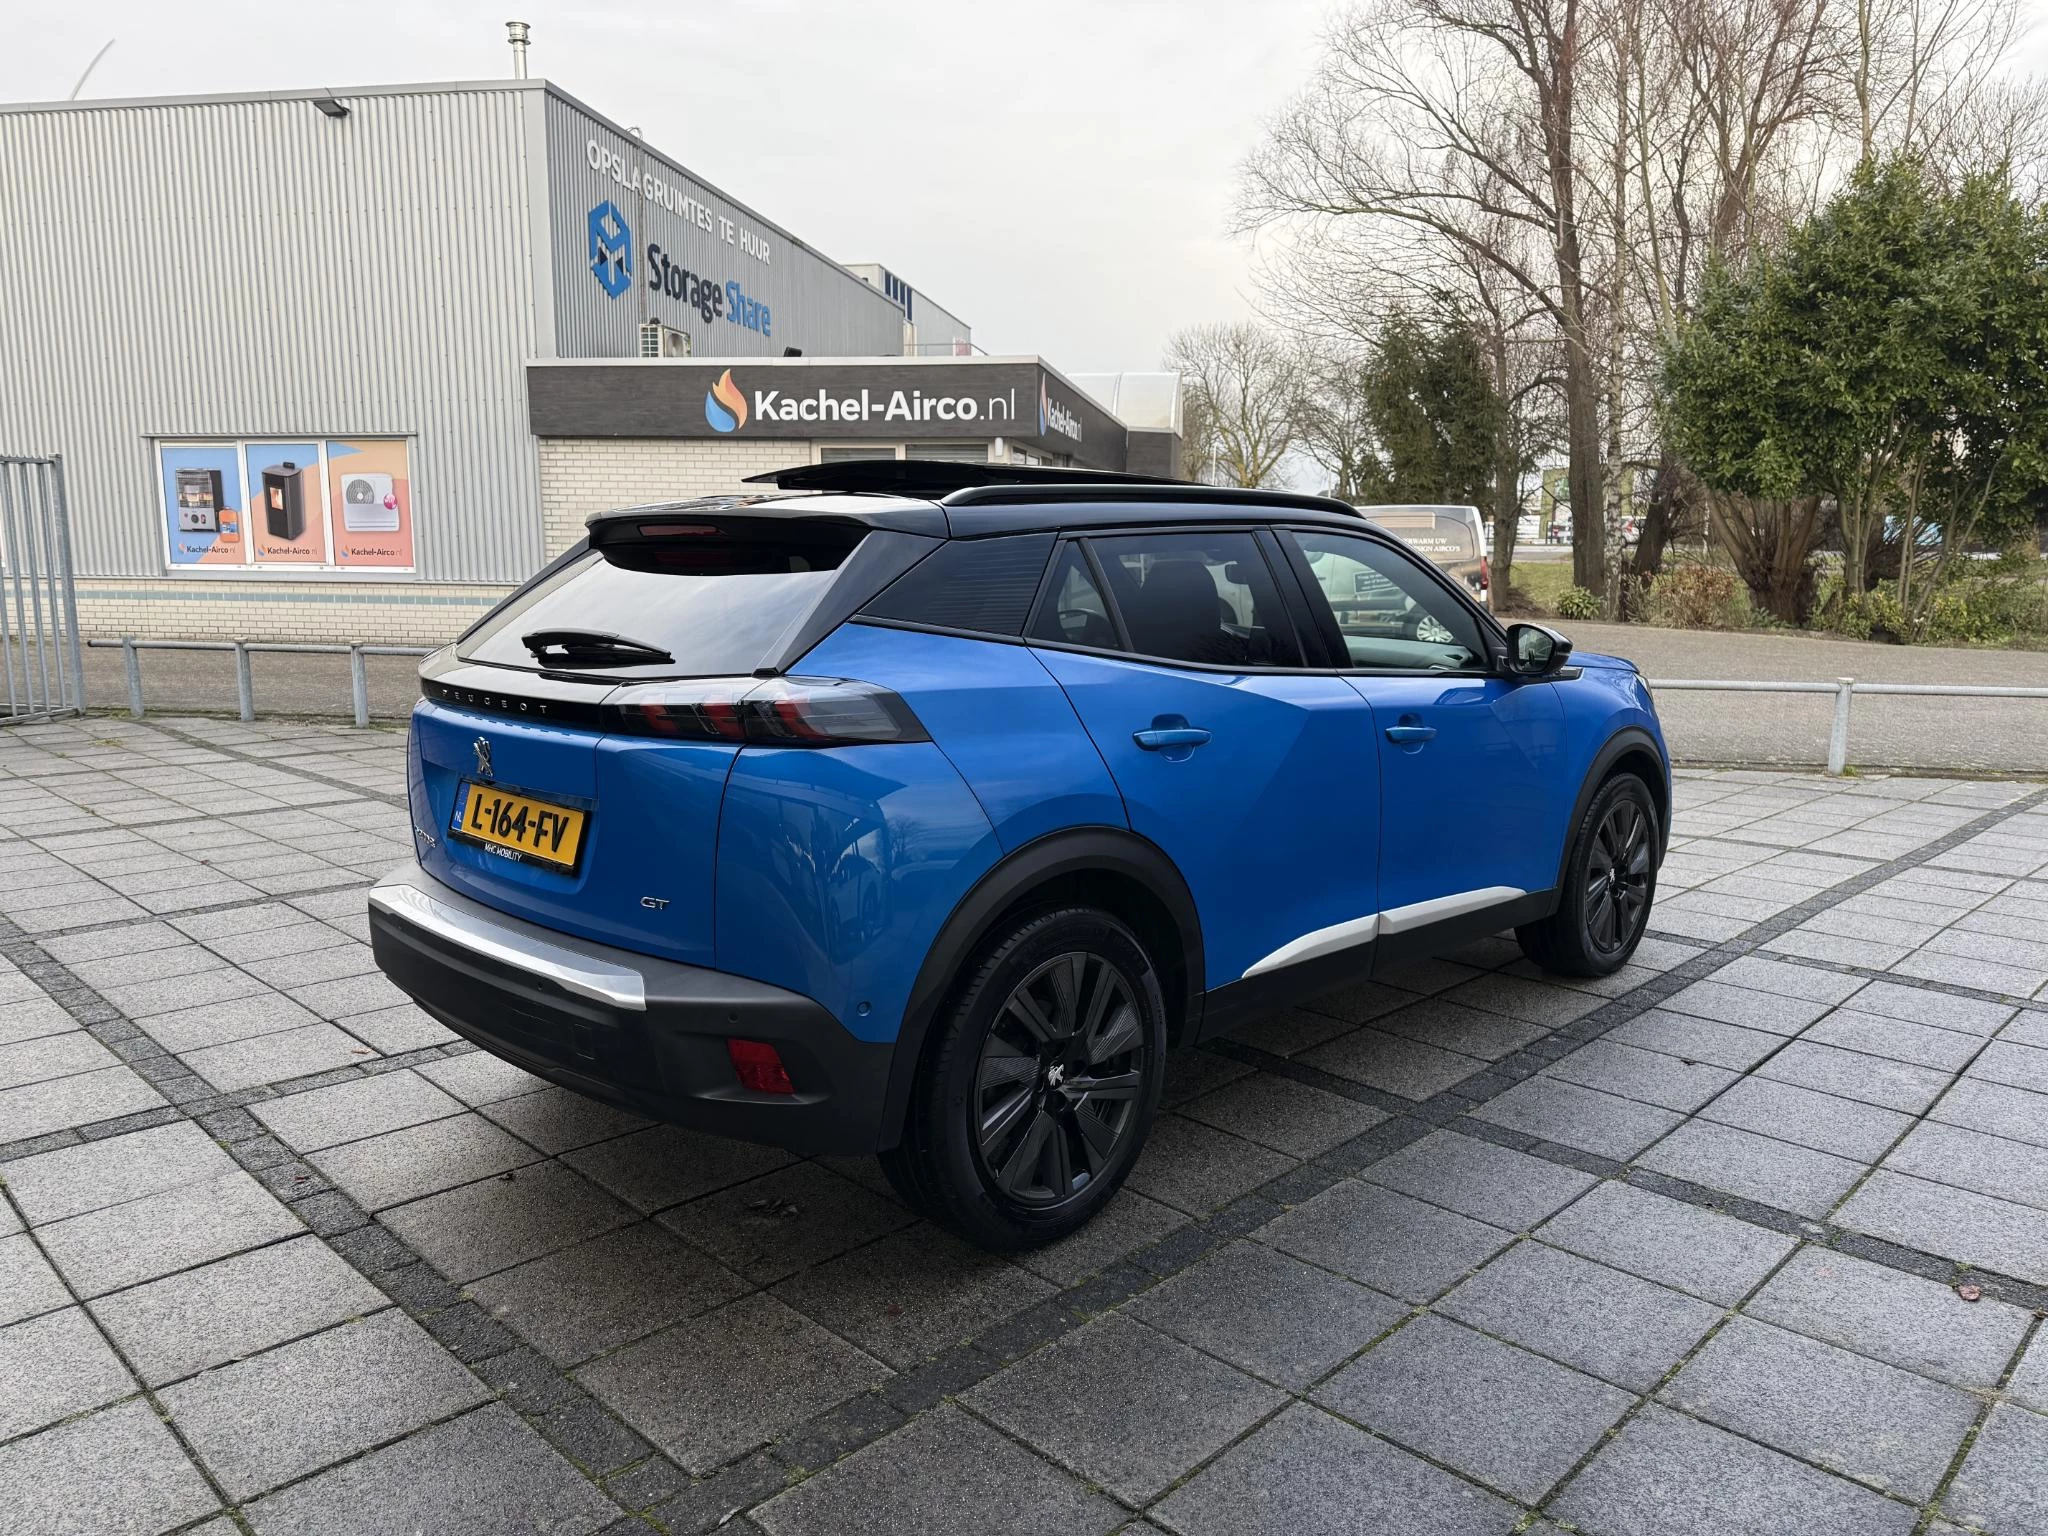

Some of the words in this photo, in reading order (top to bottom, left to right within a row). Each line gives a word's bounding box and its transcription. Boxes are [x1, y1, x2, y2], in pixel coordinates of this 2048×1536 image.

[586, 139, 713, 233] OPSLAGRUIMTES
[718, 216, 735, 245] TE
[740, 227, 771, 265] HUUR
[647, 243, 723, 324] Storage
[725, 280, 772, 337] Share
[754, 388, 1016, 422] Kachel-Airco.nl
[442, 689, 547, 714] PEUGEOT
[470, 793, 570, 853] L-164-FV
[484, 842, 497, 854] MHC
[496, 844, 522, 862] MOBILITY
[640, 896, 670, 910] GT
